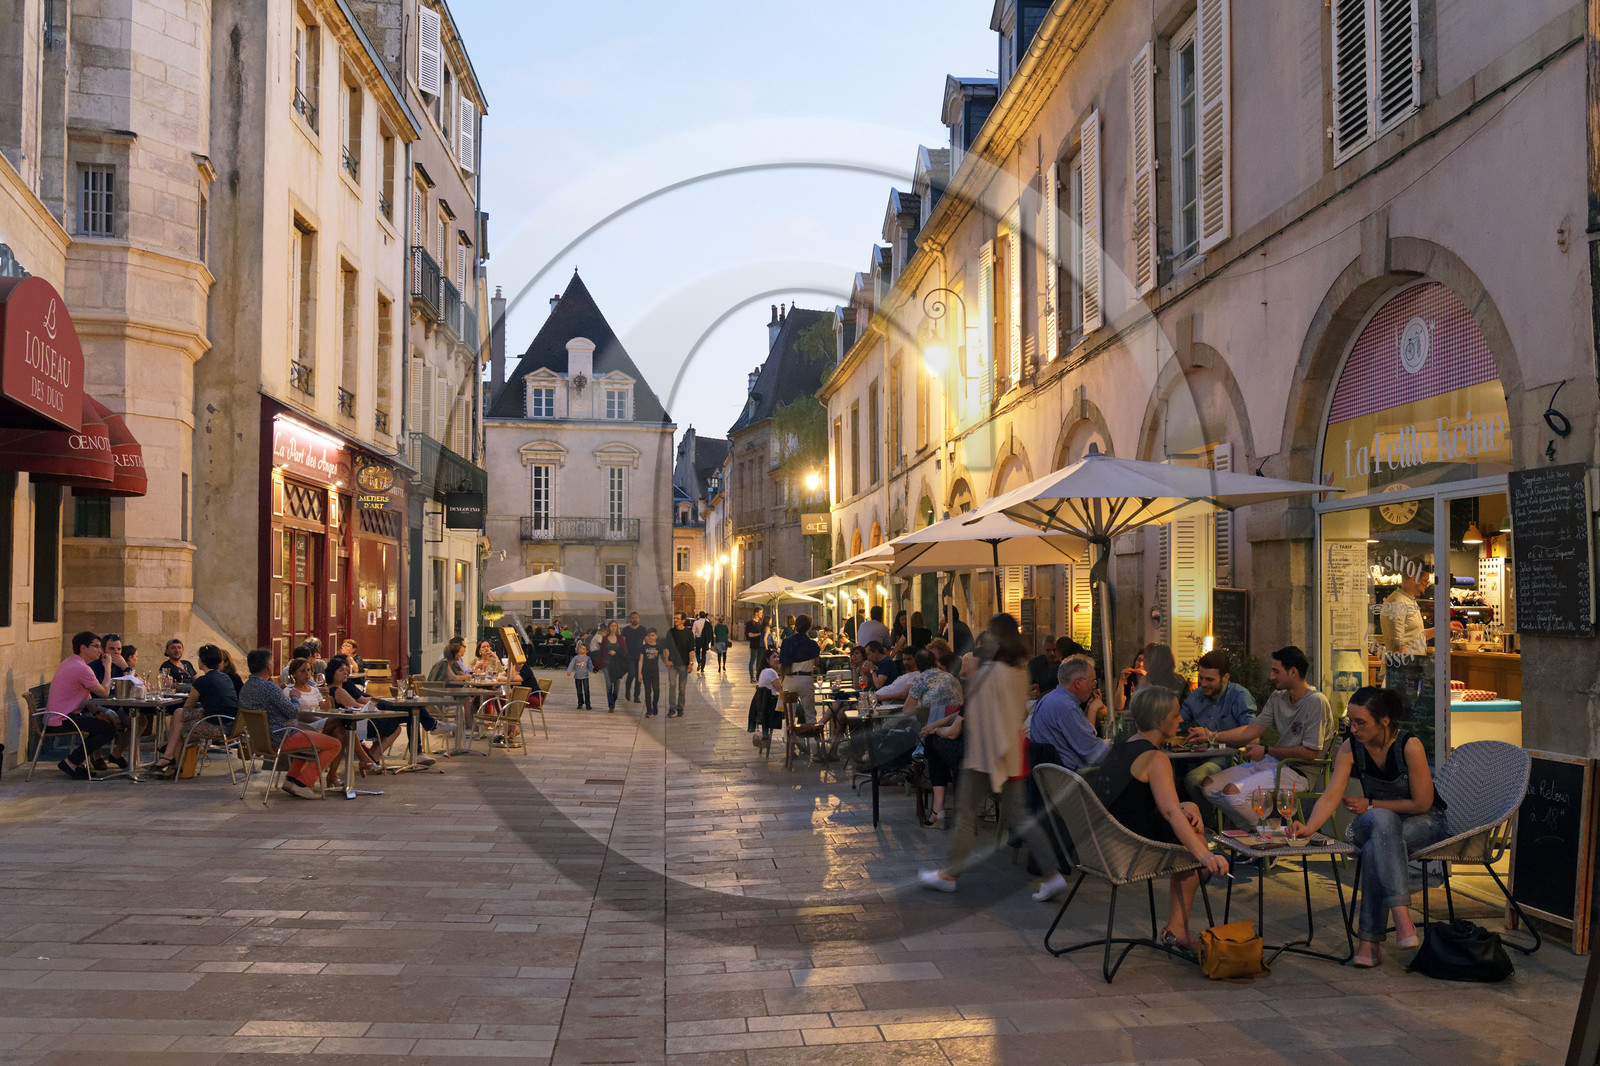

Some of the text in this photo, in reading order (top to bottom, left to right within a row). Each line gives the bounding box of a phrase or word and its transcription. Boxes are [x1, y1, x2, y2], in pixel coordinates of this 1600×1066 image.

[24, 330, 71, 388] LOISEAU
[31, 376, 64, 412] DES DUCS
[273, 431, 338, 478] La Part des Anges
[1345, 411, 1505, 479] La Petite Reine
